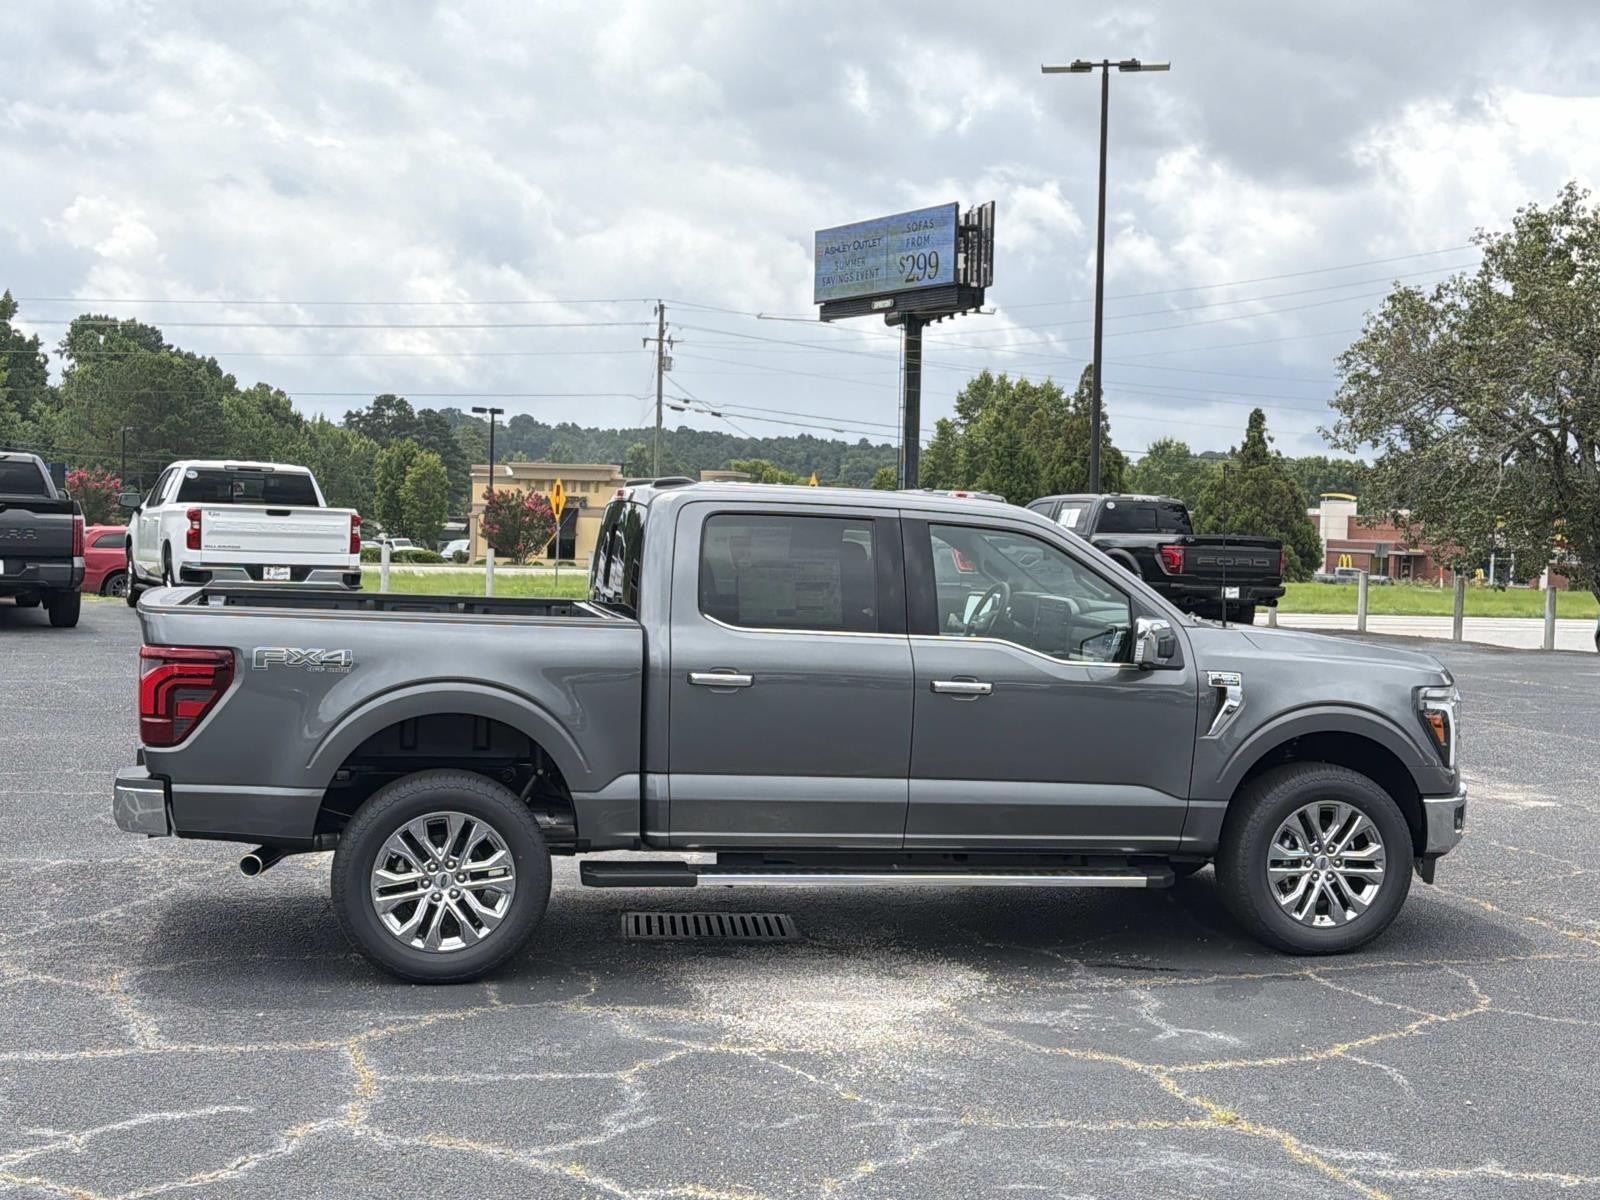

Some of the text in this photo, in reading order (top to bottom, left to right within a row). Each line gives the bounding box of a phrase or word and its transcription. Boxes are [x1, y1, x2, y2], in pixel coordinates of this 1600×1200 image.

[906, 219, 935, 233] SOFAS
[824, 237, 882, 256] ASHLEY OUTLET
[905, 234, 931, 248] FROM
[834, 256, 866, 272] SUMMER
[898, 250, 939, 283] $299
[822, 267, 880, 287] SAVINGS EVENT
[0, 528, 38, 540] RA
[1197, 556, 1270, 567] FORD
[252, 646, 353, 671] FX4
